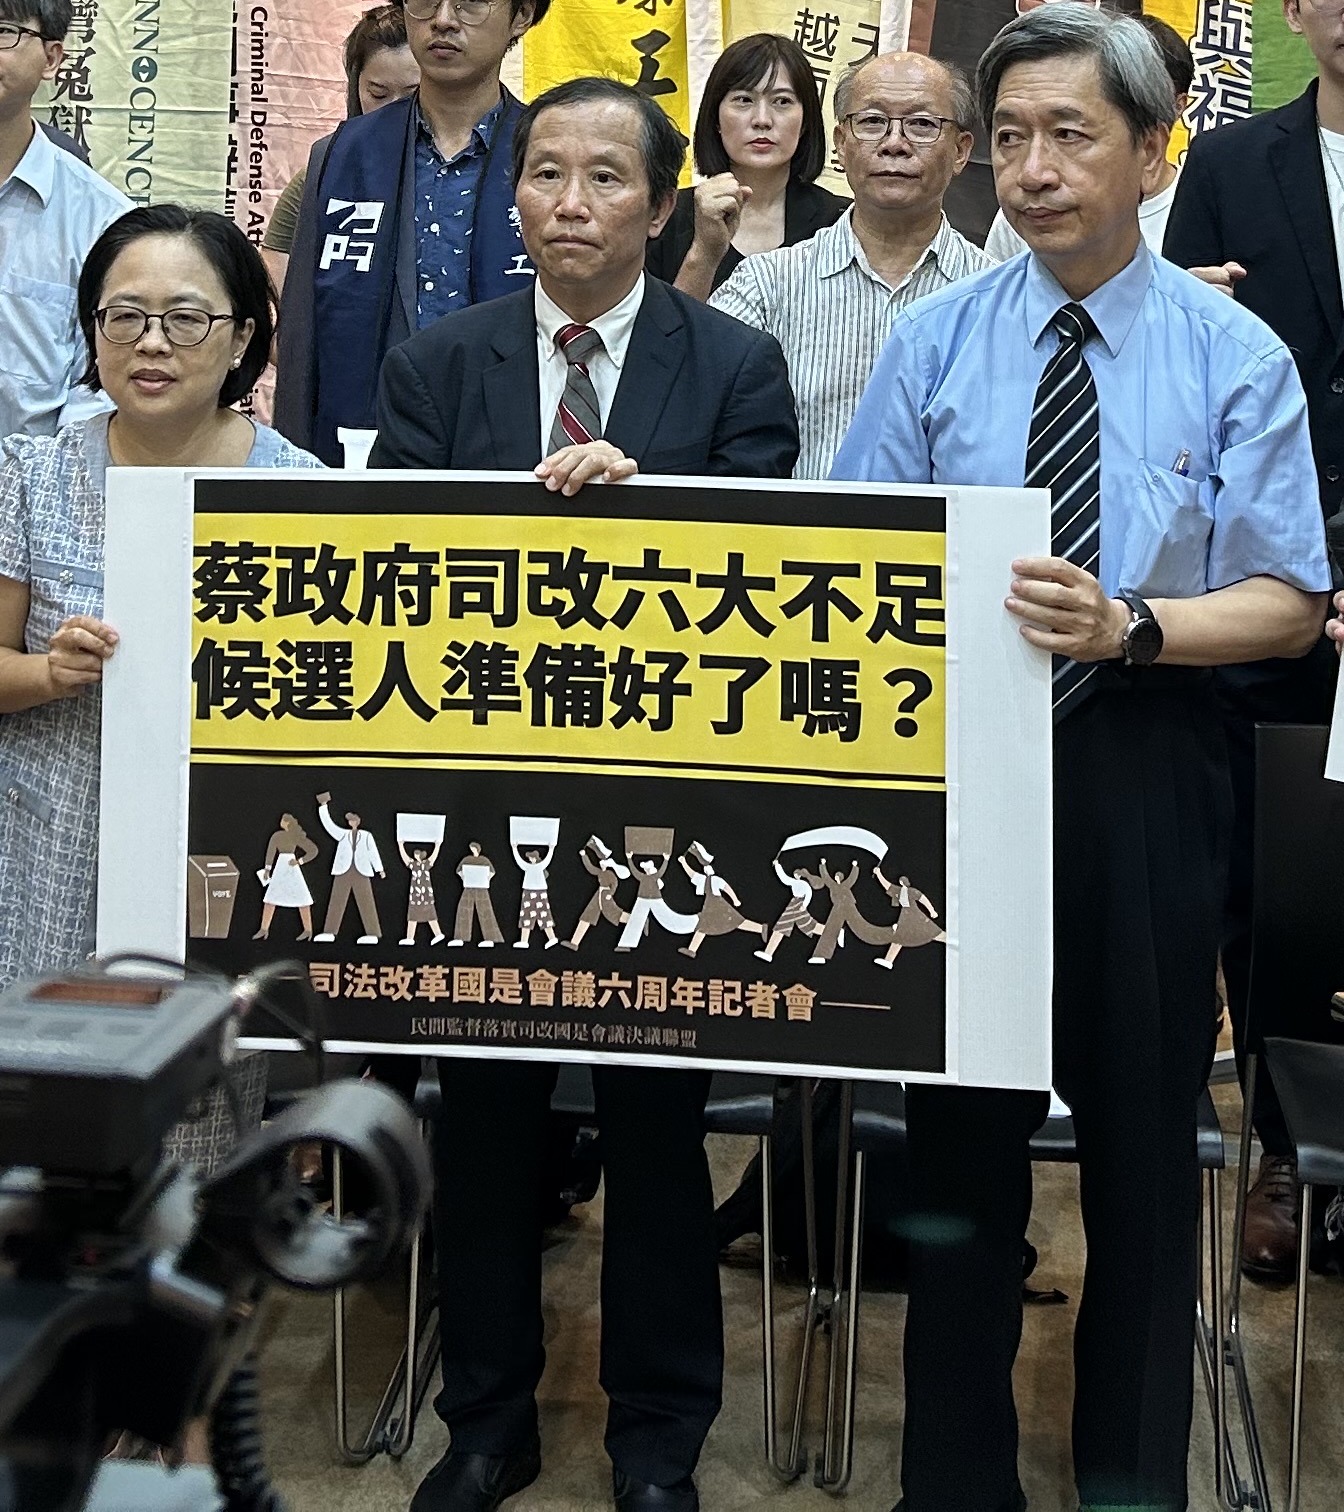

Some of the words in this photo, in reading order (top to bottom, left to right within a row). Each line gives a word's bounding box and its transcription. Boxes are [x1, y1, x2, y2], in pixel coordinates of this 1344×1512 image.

[250, 6, 269, 103] Criminal
[248, 110, 268, 204] Defense
[192, 540, 946, 647] 蔡政府司改六大不足
[192, 637, 936, 744] 候選人準備好了嗎？
[308, 962, 818, 1022] 司法改革國是會議六周年記者會
[410, 1017, 697, 1049] 民間監督落實司改國是會議決議聯盟
